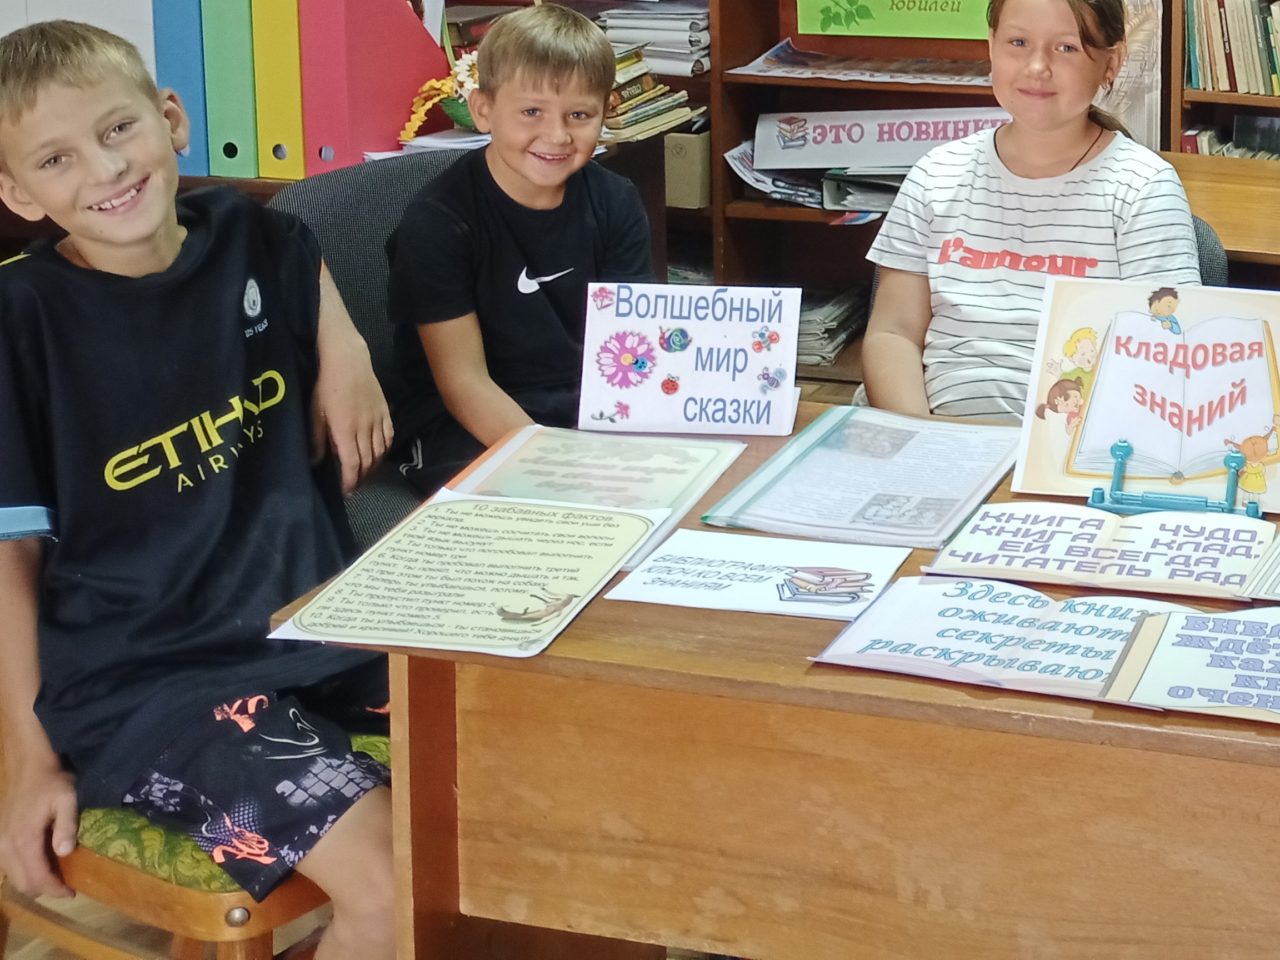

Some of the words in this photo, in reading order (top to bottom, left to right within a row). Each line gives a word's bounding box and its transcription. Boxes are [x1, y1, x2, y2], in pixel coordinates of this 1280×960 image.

[812, 122, 865, 145] ЭТО
[615, 284, 783, 324] Волшебный
[694, 346, 749, 381] мир
[683, 396, 772, 425] сказки
[472, 504, 488, 512] 10
[490, 505, 557, 518] забавных
[979, 511, 1105, 530] КНИГА
[1159, 523, 1265, 544] ЧУДО,
[969, 523, 1097, 544] КНИГА
[1149, 537, 1261, 559] КЛАД,
[998, 538, 1051, 554] ЕЙ
[1065, 545, 1219, 568] ВСЕГДА
[948, 549, 1151, 577] ЧИТАТЕЛЬ
[1167, 569, 1248, 588] РАД
[942, 581, 1050, 610] Здесь
[936, 626, 1115, 662] секреты
